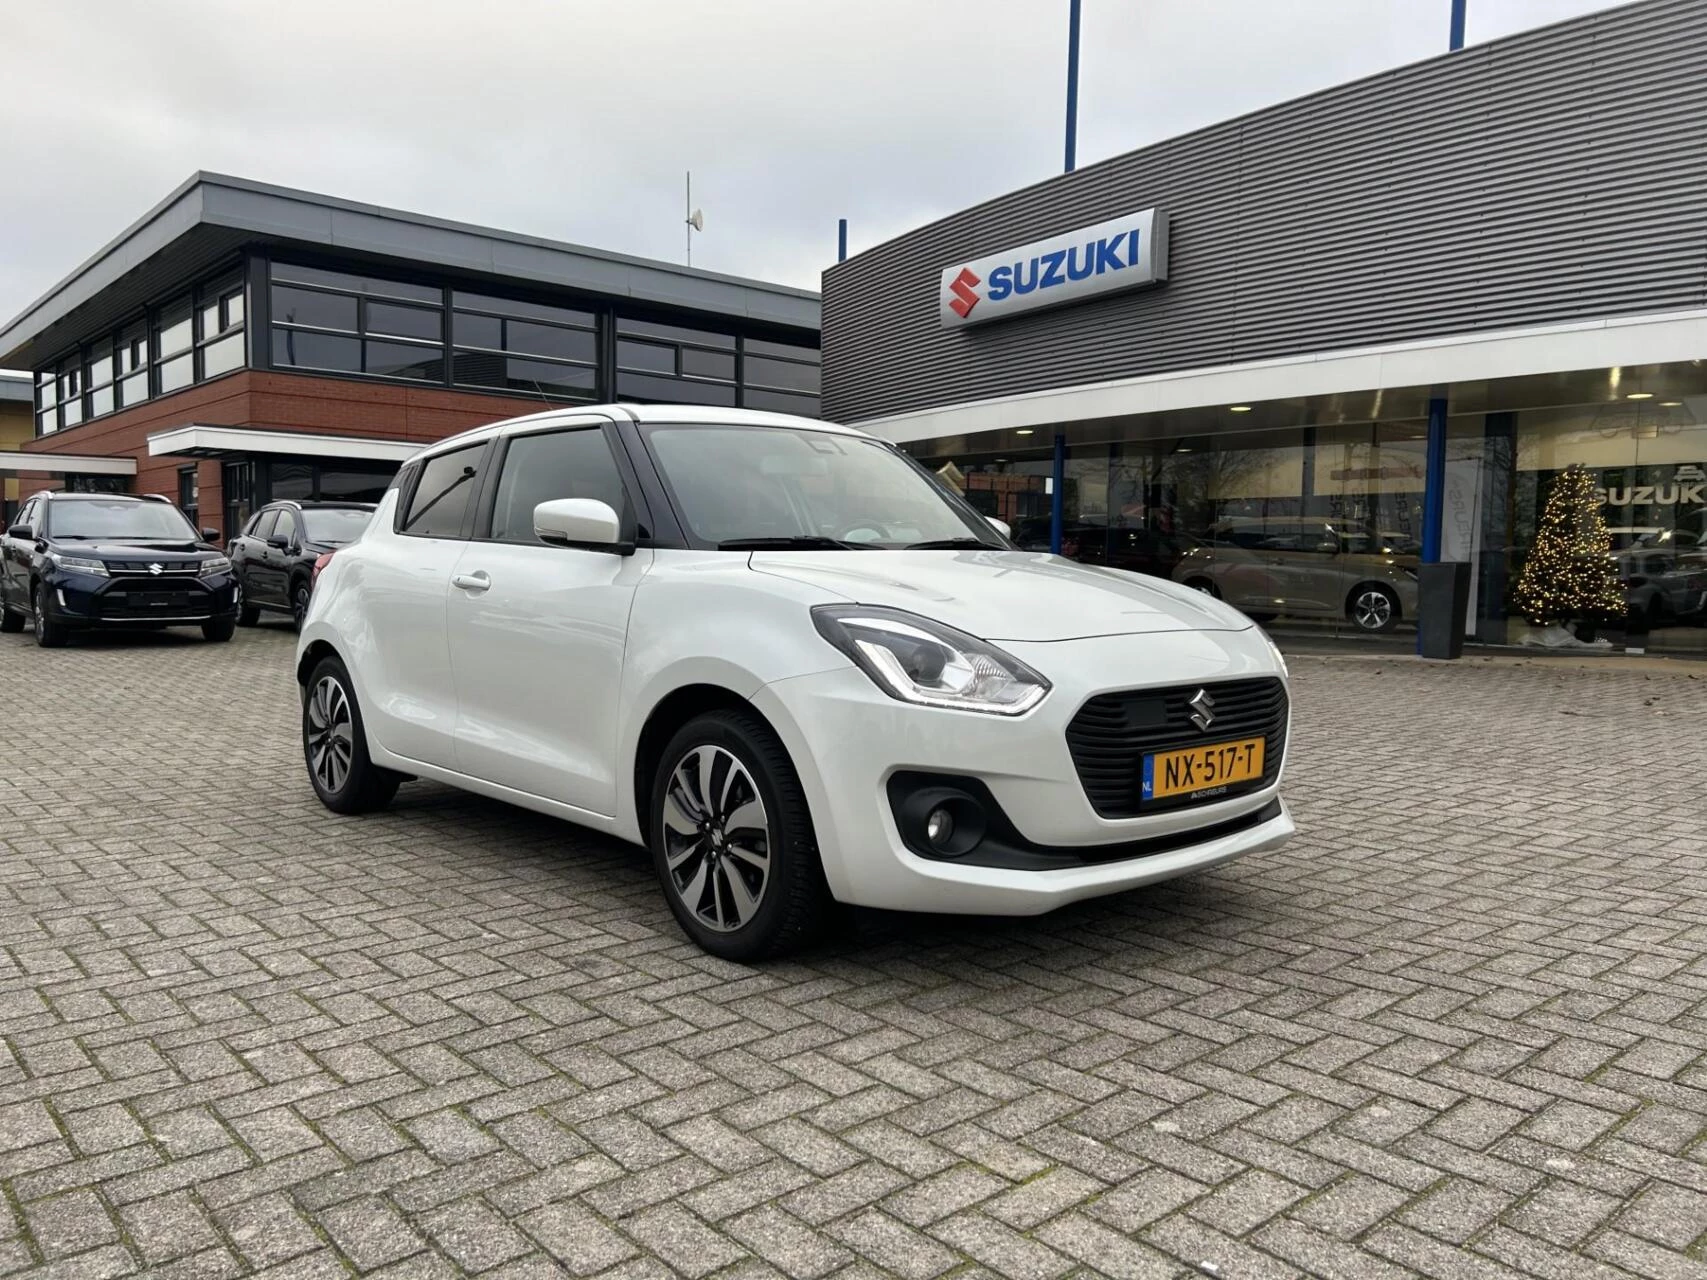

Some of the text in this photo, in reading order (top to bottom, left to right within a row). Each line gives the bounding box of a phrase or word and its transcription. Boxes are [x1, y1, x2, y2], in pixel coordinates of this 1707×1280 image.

[988, 229, 1140, 300] SUZUKI
[1142, 781, 1152, 793] NL
[1165, 743, 1255, 789] NX-517-T
